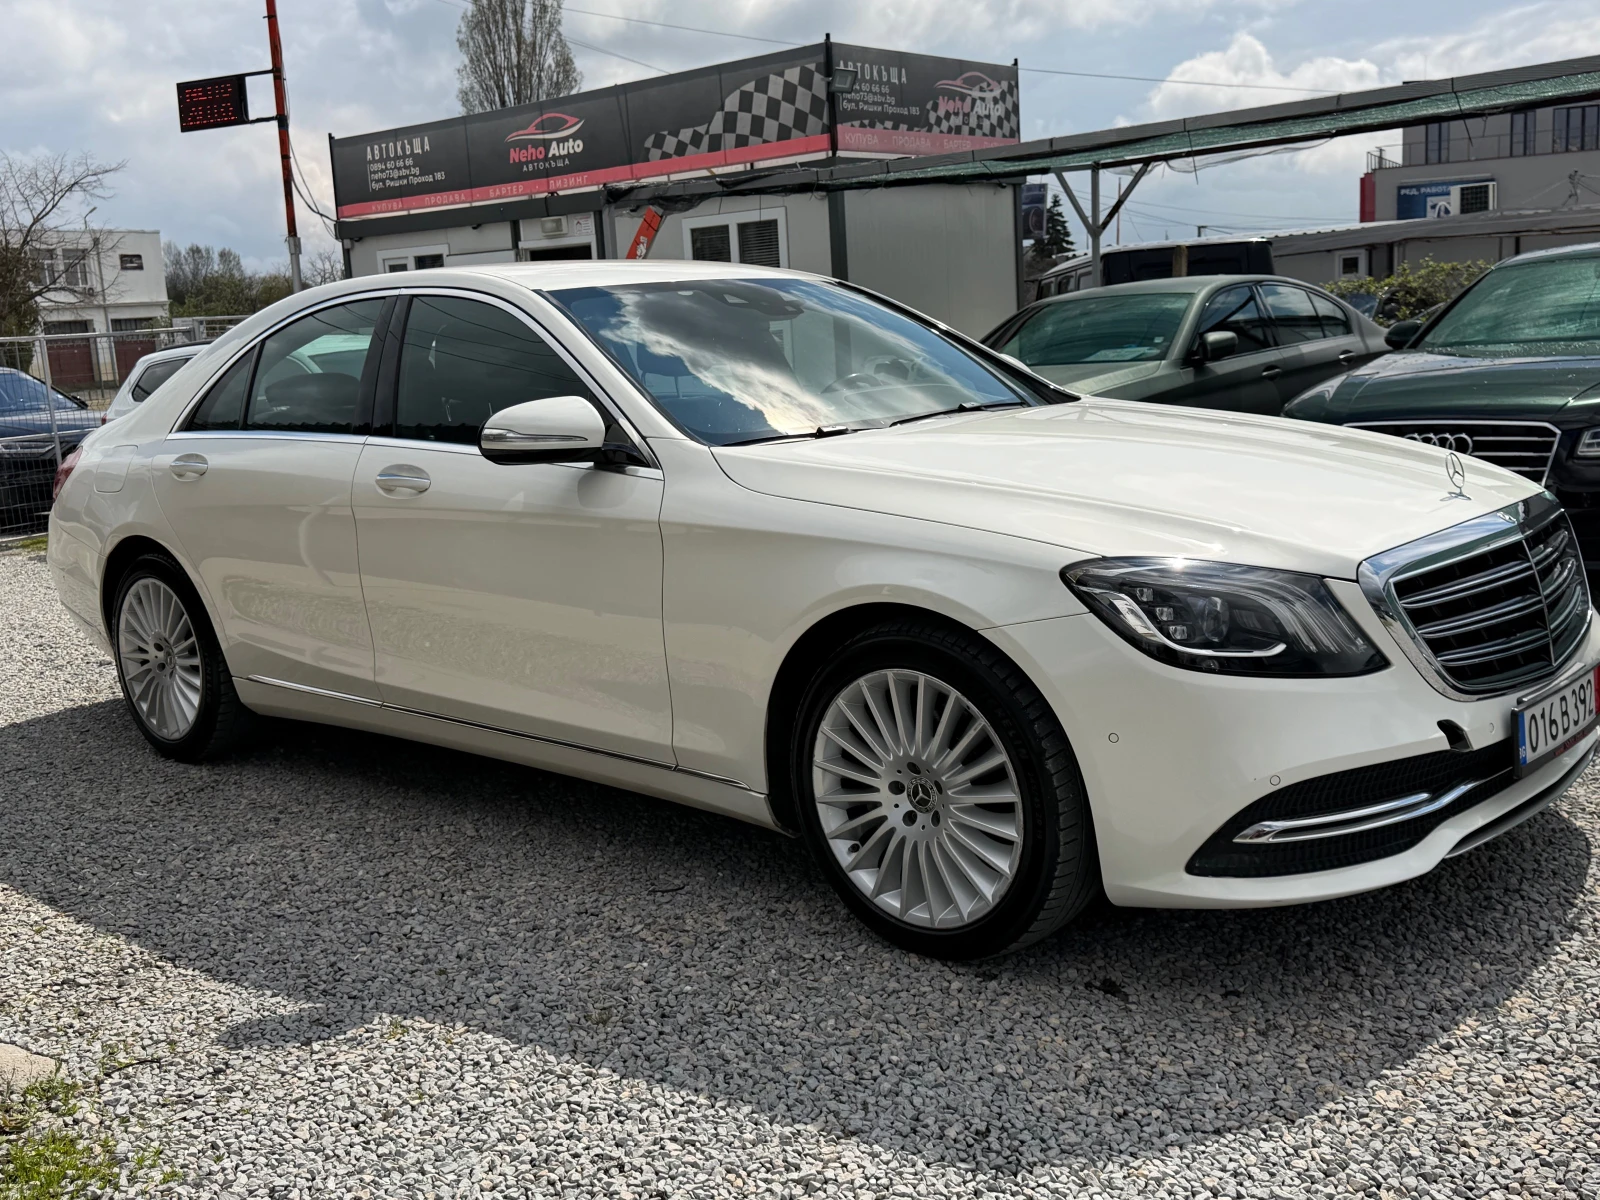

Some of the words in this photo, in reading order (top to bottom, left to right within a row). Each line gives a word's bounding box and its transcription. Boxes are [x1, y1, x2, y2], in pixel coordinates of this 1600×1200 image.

[861, 83, 870, 91] 60
[871, 84, 880, 92] 66
[881, 85, 890, 93] 66
[842, 92, 896, 105] neho73@abv.bg
[842, 100, 858, 111] бул.
[859, 102, 882, 112] Ришки
[883, 104, 909, 115] Проход
[973, 99, 1001, 116] Auto
[844, 132, 879, 145] КУПУВА
[892, 135, 931, 148] ПРОДАВА
[366, 136, 430, 161] АВТОКЪЩА
[509, 144, 546, 163] Neho
[548, 138, 584, 158] Auto
[370, 162, 385, 171] 0894
[386, 160, 395, 169] 60
[396, 159, 404, 168] 66
[405, 157, 413, 166] 66
[522, 158, 570, 172] АВТОКЪЩА
[371, 167, 420, 180] neho73@abv.bg
[371, 180, 385, 190] бул.
[386, 178, 408, 188] Ришки
[408, 174, 433, 185] Проход
[434, 171, 446, 180] 183
[371, 201, 403, 212] КУПУВА
[424, 193, 466, 205] ПРОДАВА
[489, 185, 524, 198] БАРТЕР
